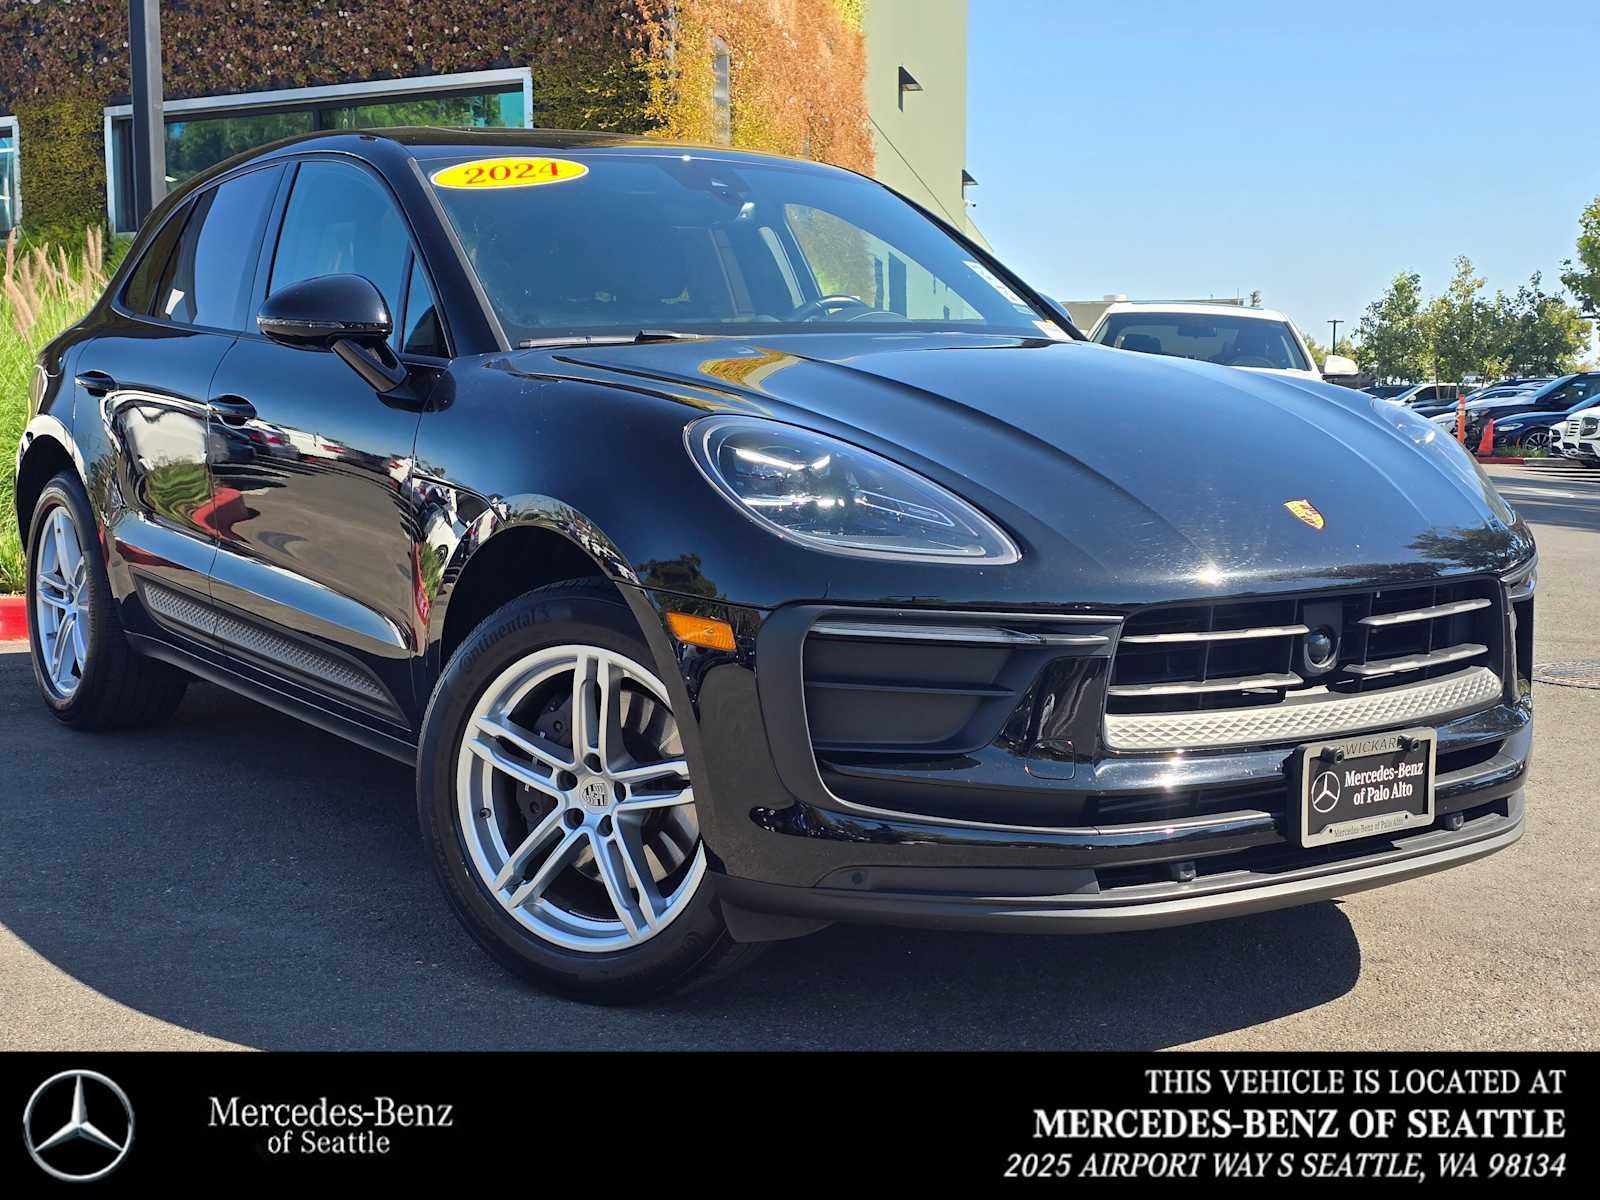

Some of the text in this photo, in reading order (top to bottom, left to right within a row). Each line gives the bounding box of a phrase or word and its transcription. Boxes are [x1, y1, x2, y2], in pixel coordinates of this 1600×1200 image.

[465, 162, 559, 184] 2024
[461, 609, 536, 672] Continental
[1339, 736, 1403, 755] WICKAR
[1344, 761, 1424, 788] Mercedes-Benz
[1353, 782, 1413, 805] of Palo Alto
